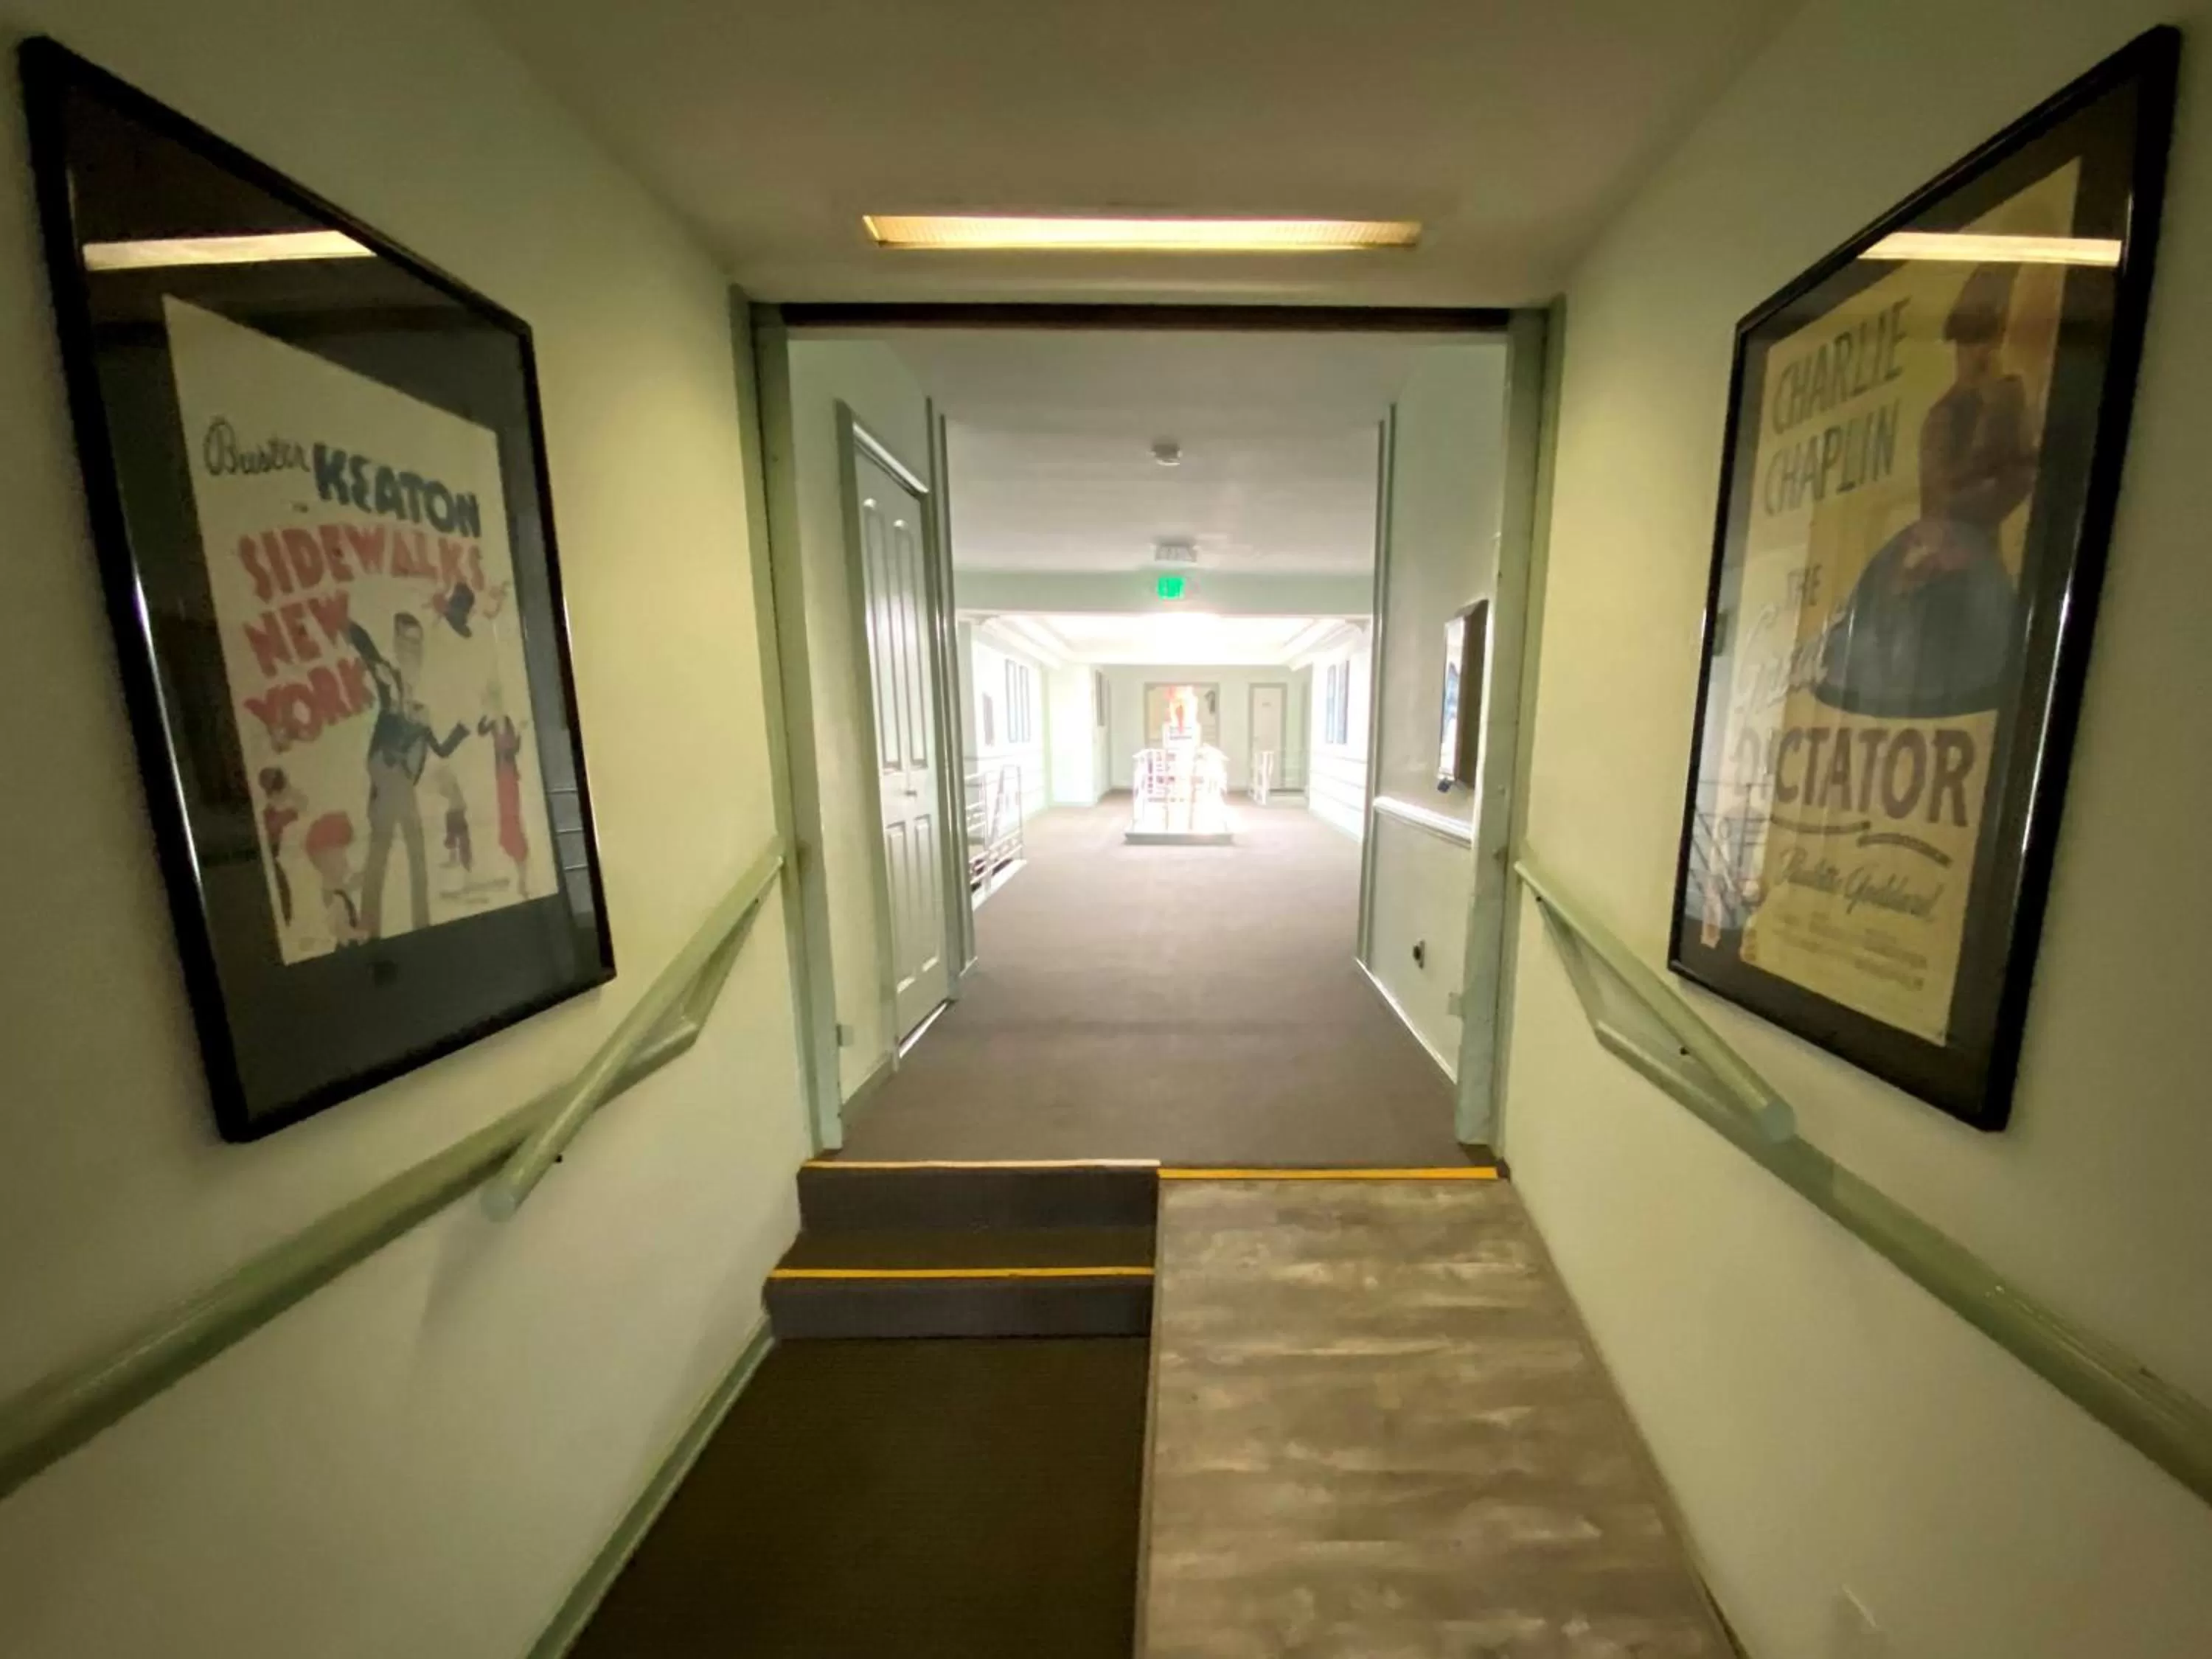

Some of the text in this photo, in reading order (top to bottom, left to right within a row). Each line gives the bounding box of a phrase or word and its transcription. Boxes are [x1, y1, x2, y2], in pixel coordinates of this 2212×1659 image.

[1773, 296, 1911, 435] CHARLIE
[204, 417, 481, 538] Buster KEATON
[1764, 400, 1899, 516] CHAPLIN
[237, 523, 485, 603] SIDEWALKS
[242, 590, 351, 677] NEW
[243, 656, 375, 743] YORK
